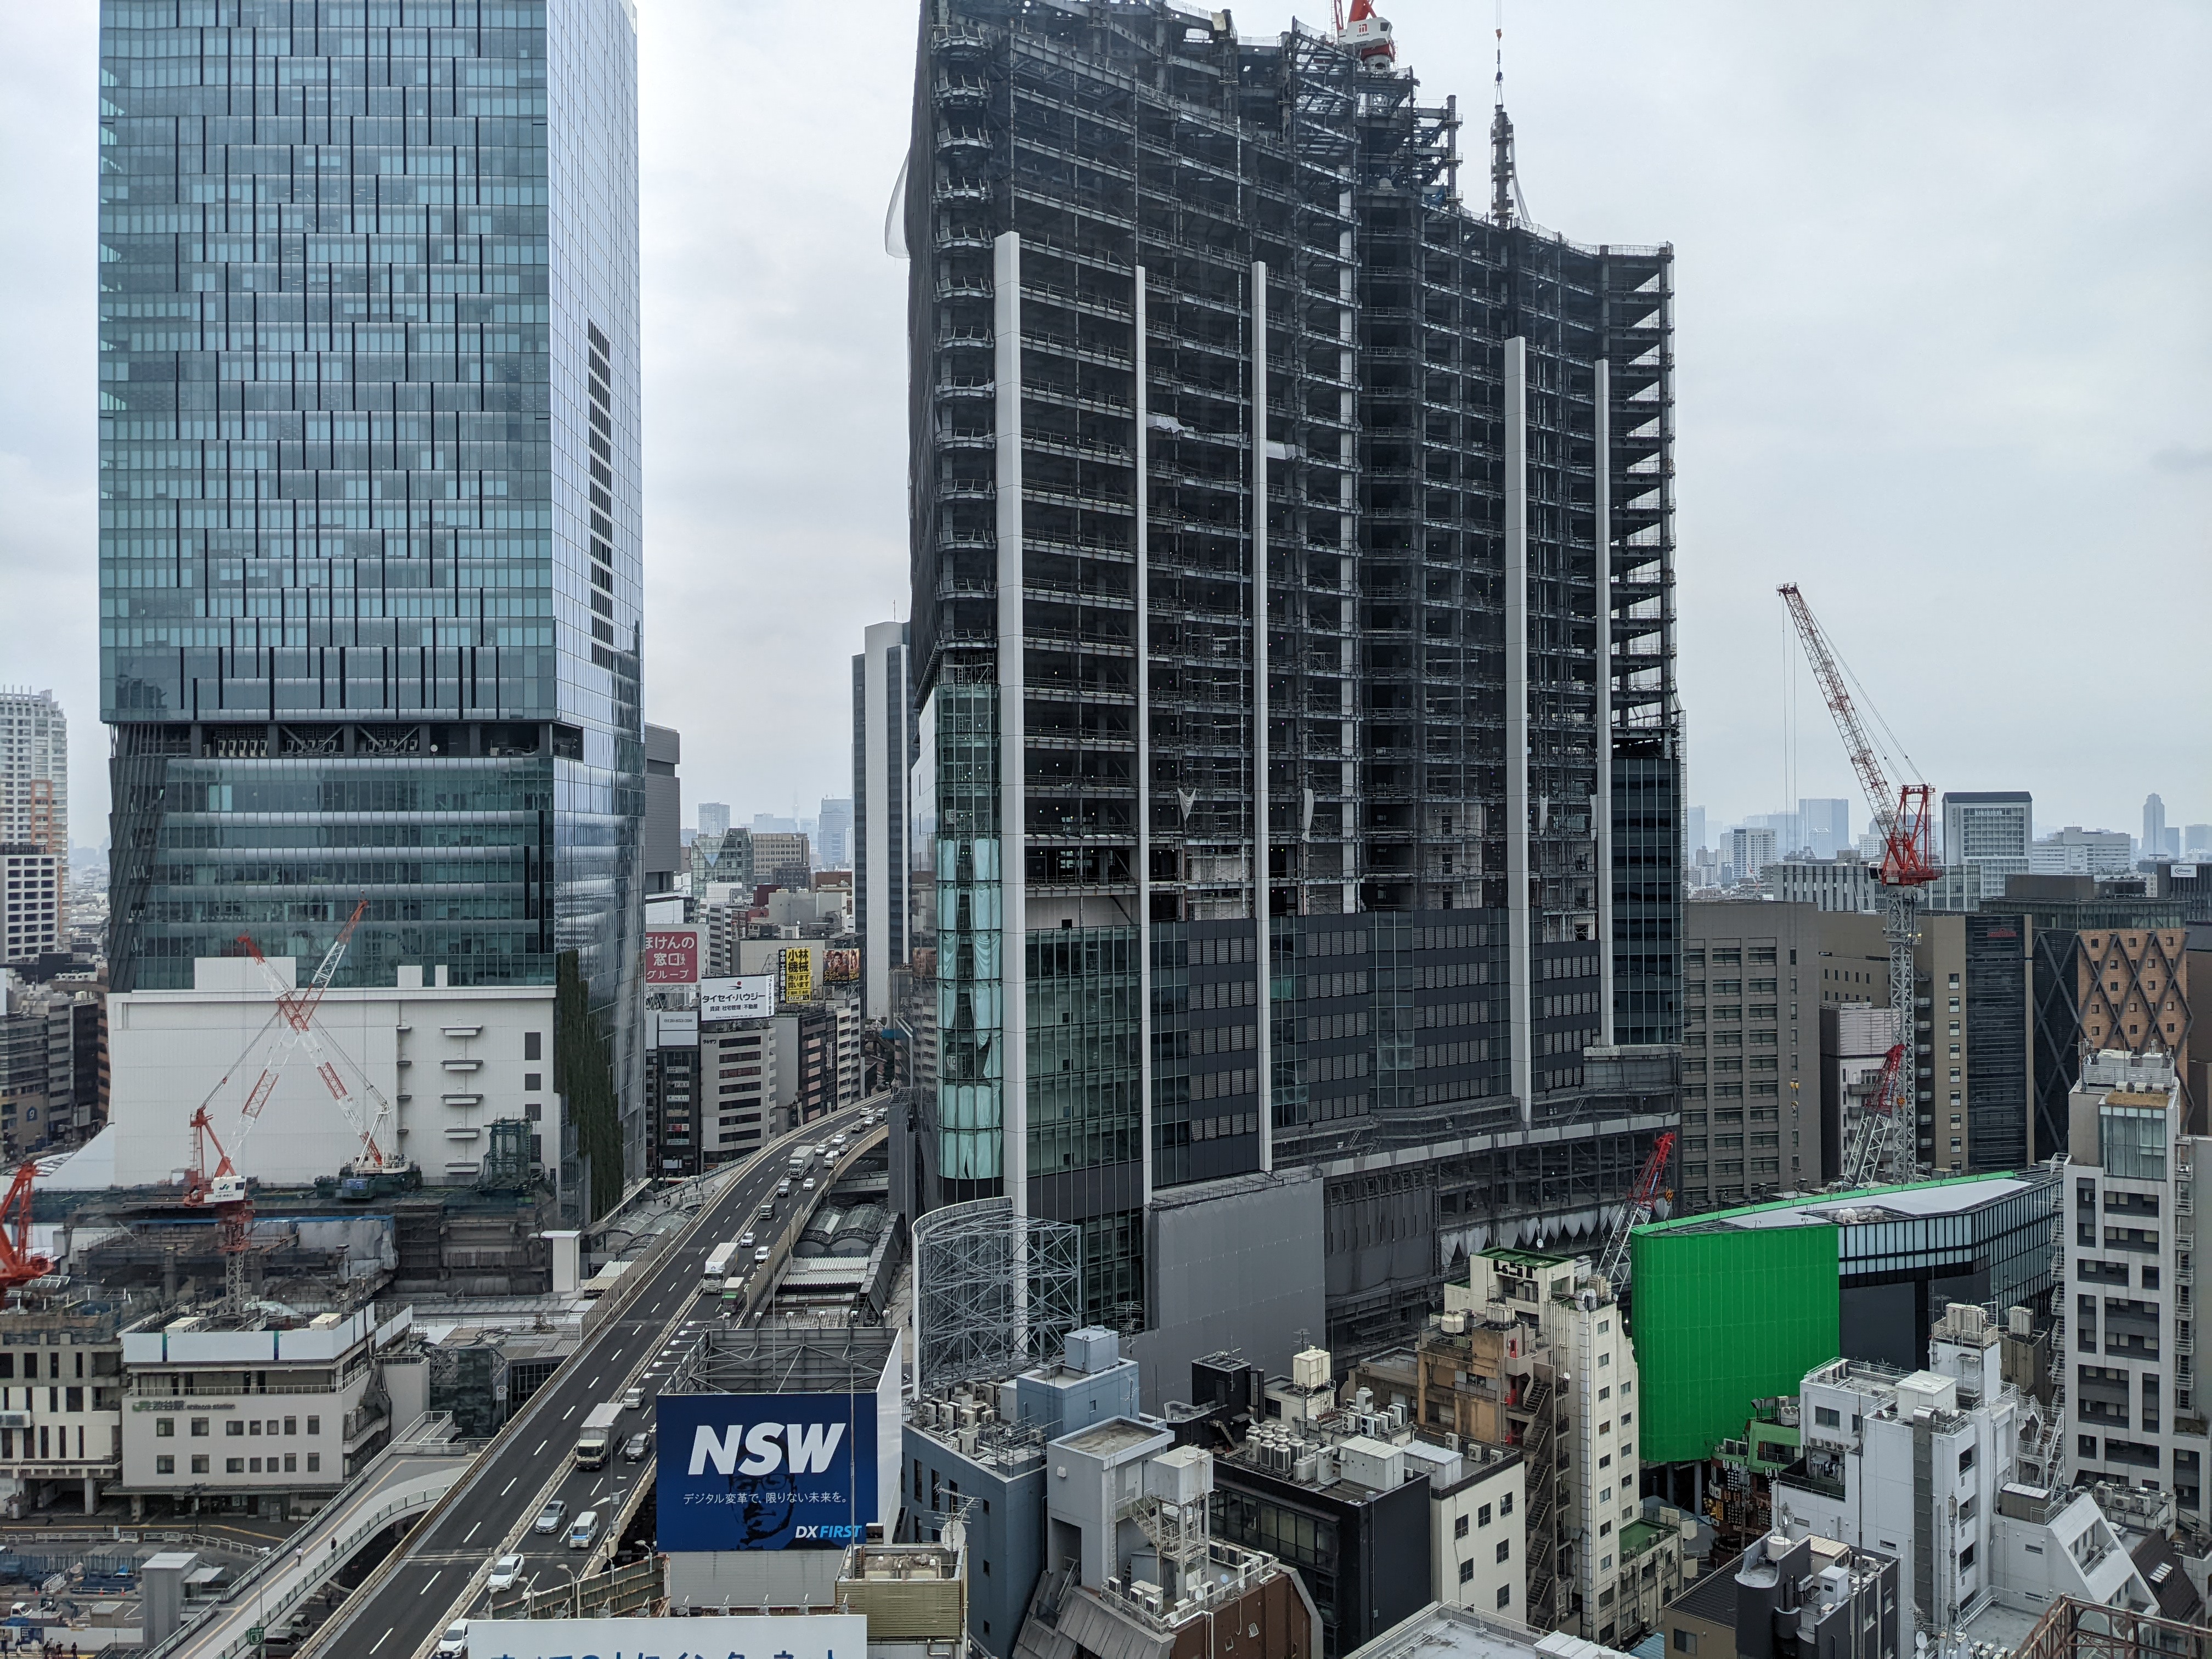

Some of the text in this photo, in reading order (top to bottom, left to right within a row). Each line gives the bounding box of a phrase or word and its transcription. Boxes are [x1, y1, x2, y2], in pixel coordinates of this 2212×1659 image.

[788, 949, 809, 961] 小林
[788, 961, 809, 973] 機械
[647, 969, 689, 979] グループ
[688, 1422, 846, 1476] NSW
[683, 1492, 848, 1505] デジタル変革で、限りない未来を。
[795, 1525, 862, 1538] DX FIRST
